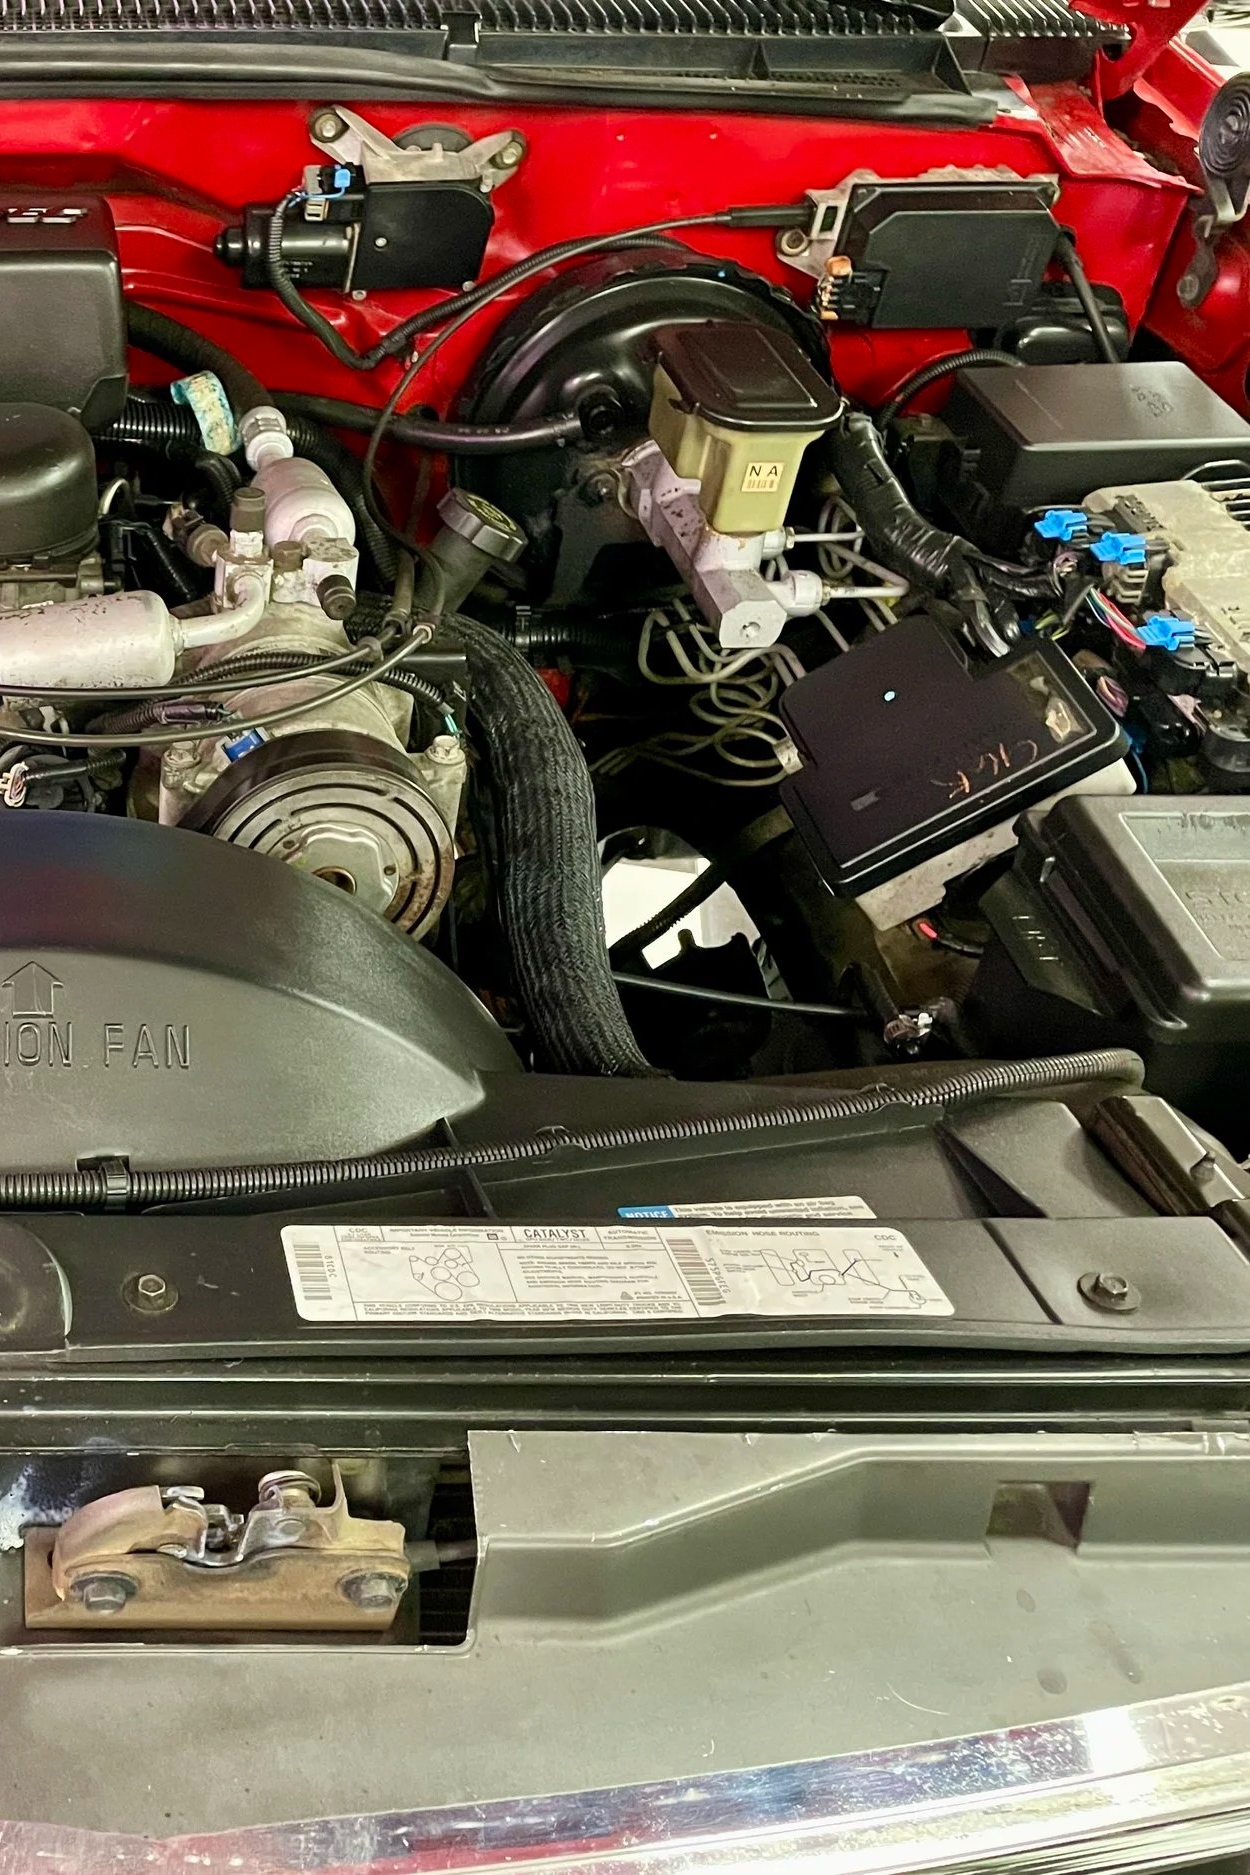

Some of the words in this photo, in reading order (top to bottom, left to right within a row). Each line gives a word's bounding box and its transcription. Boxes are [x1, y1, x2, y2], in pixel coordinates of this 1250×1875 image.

[103, 1023, 191, 1069] FAN
[523, 1228, 586, 1239] CATALYST
[705, 1229, 748, 1237] EMISSION
